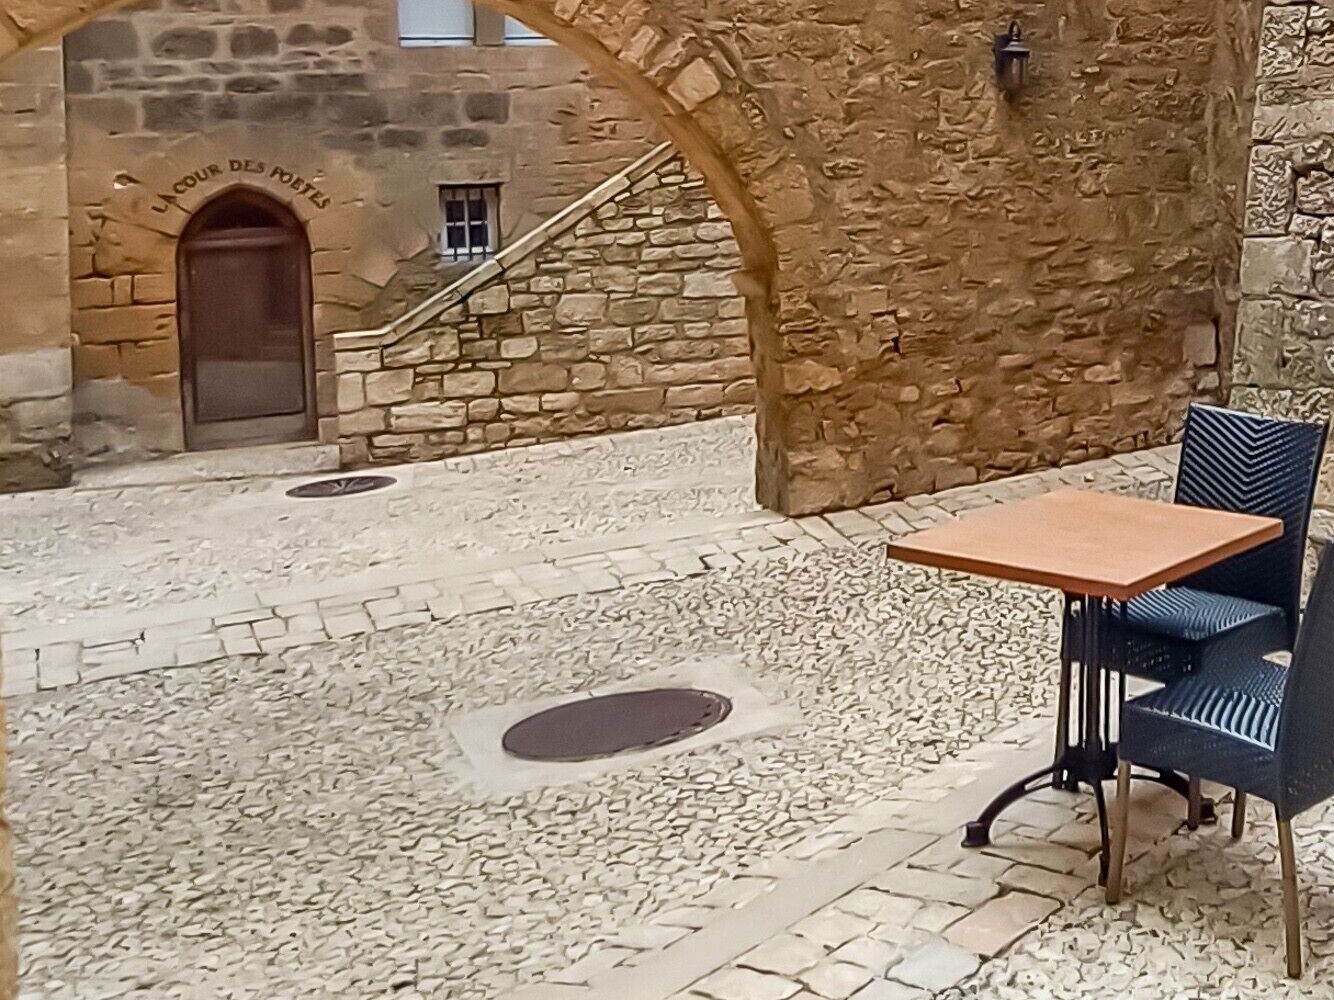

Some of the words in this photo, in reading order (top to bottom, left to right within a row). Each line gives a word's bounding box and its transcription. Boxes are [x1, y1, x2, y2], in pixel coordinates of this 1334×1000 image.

[151, 193, 178, 214] LA
[173, 164, 223, 194] COUR
[229, 159, 264, 173] DES
